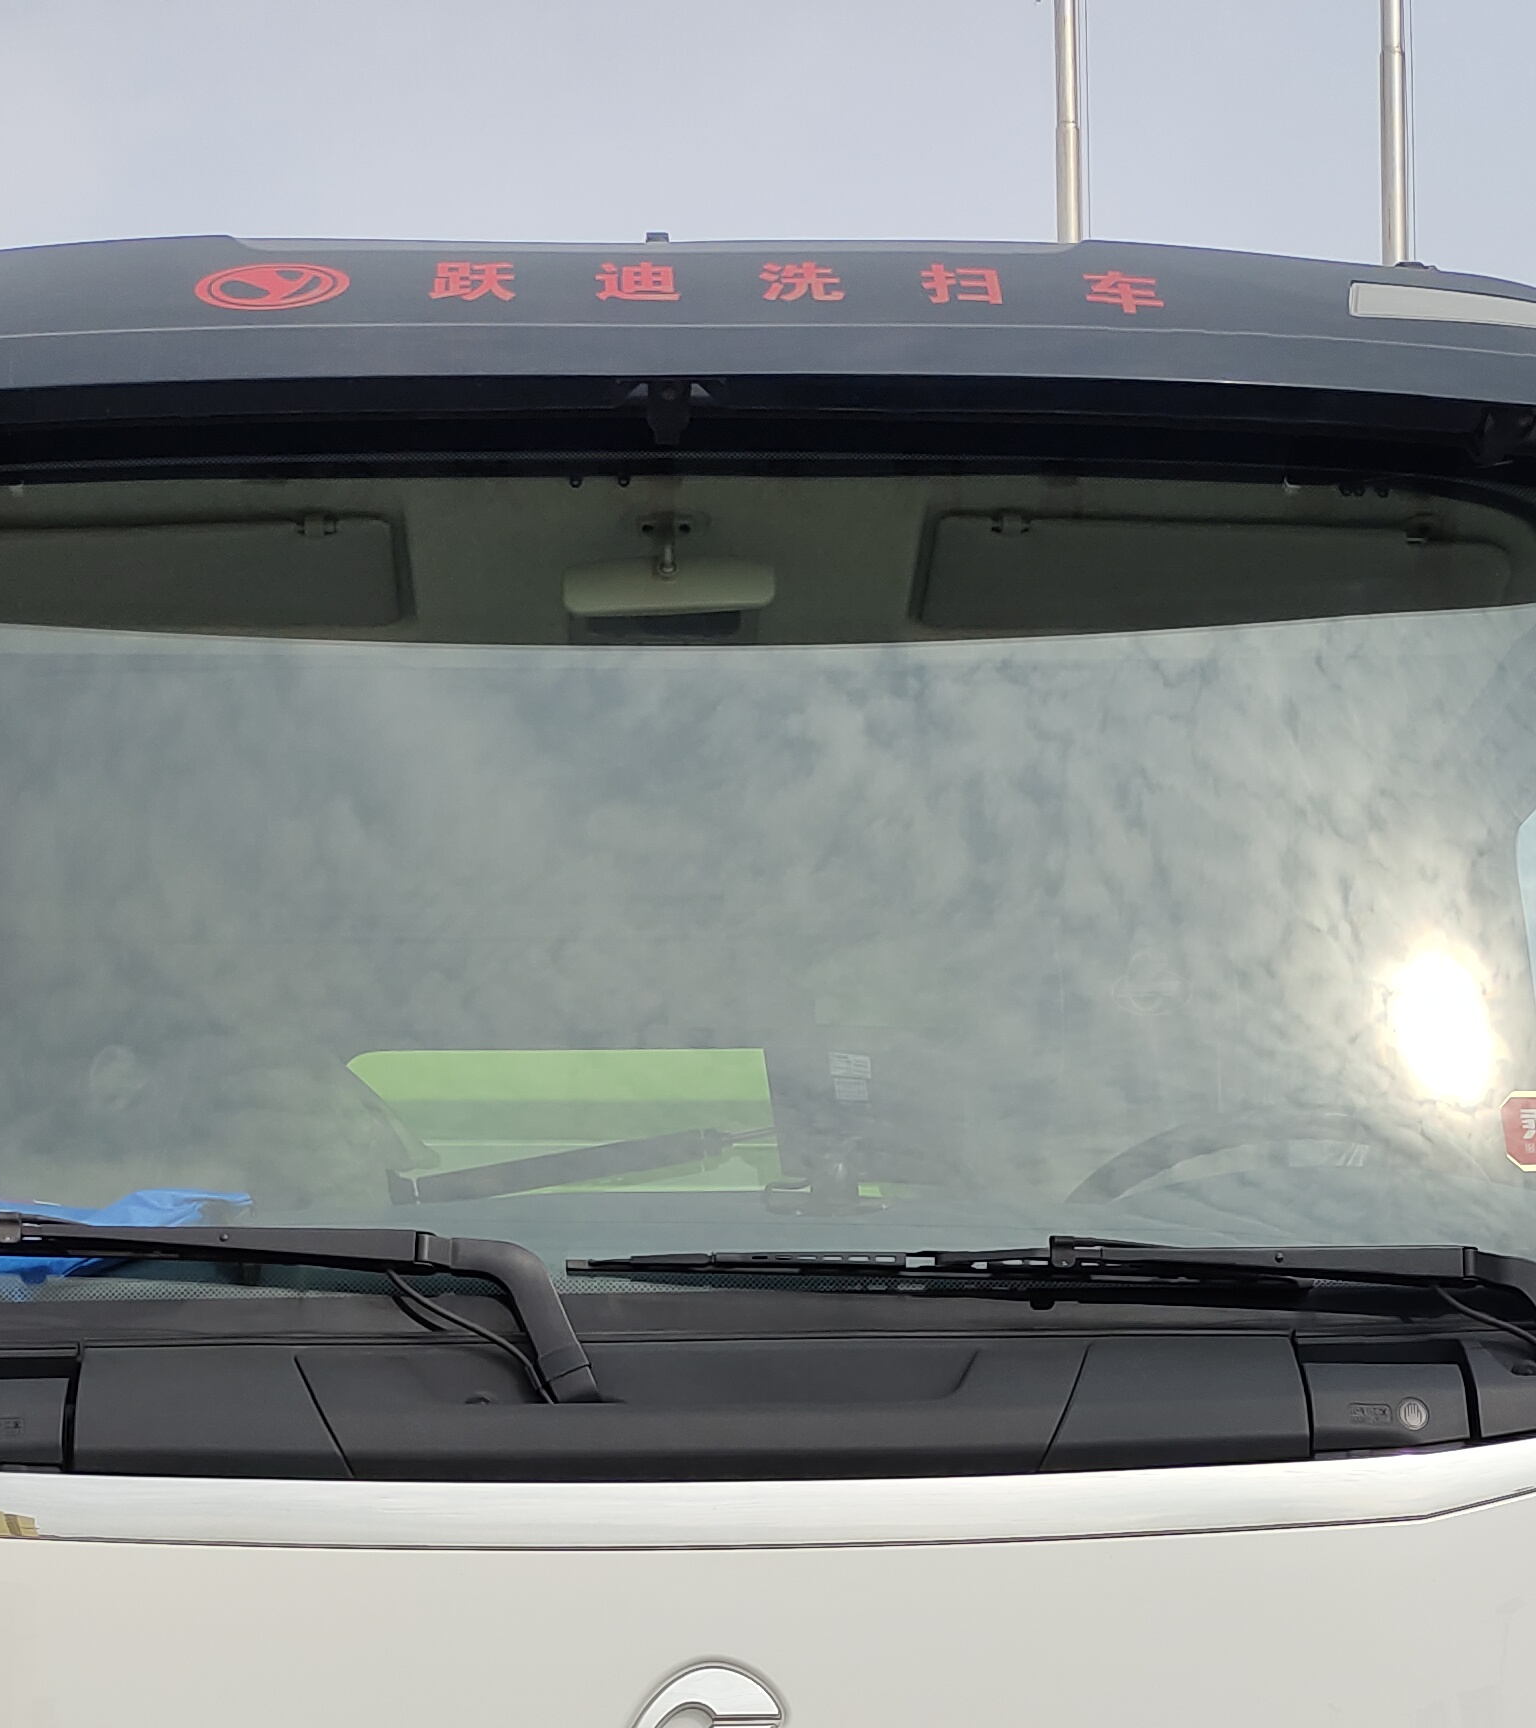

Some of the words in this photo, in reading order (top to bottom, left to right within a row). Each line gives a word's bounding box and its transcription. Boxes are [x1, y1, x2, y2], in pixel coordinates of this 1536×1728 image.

[429, 261, 1164, 315] 跃迪洗扫车
